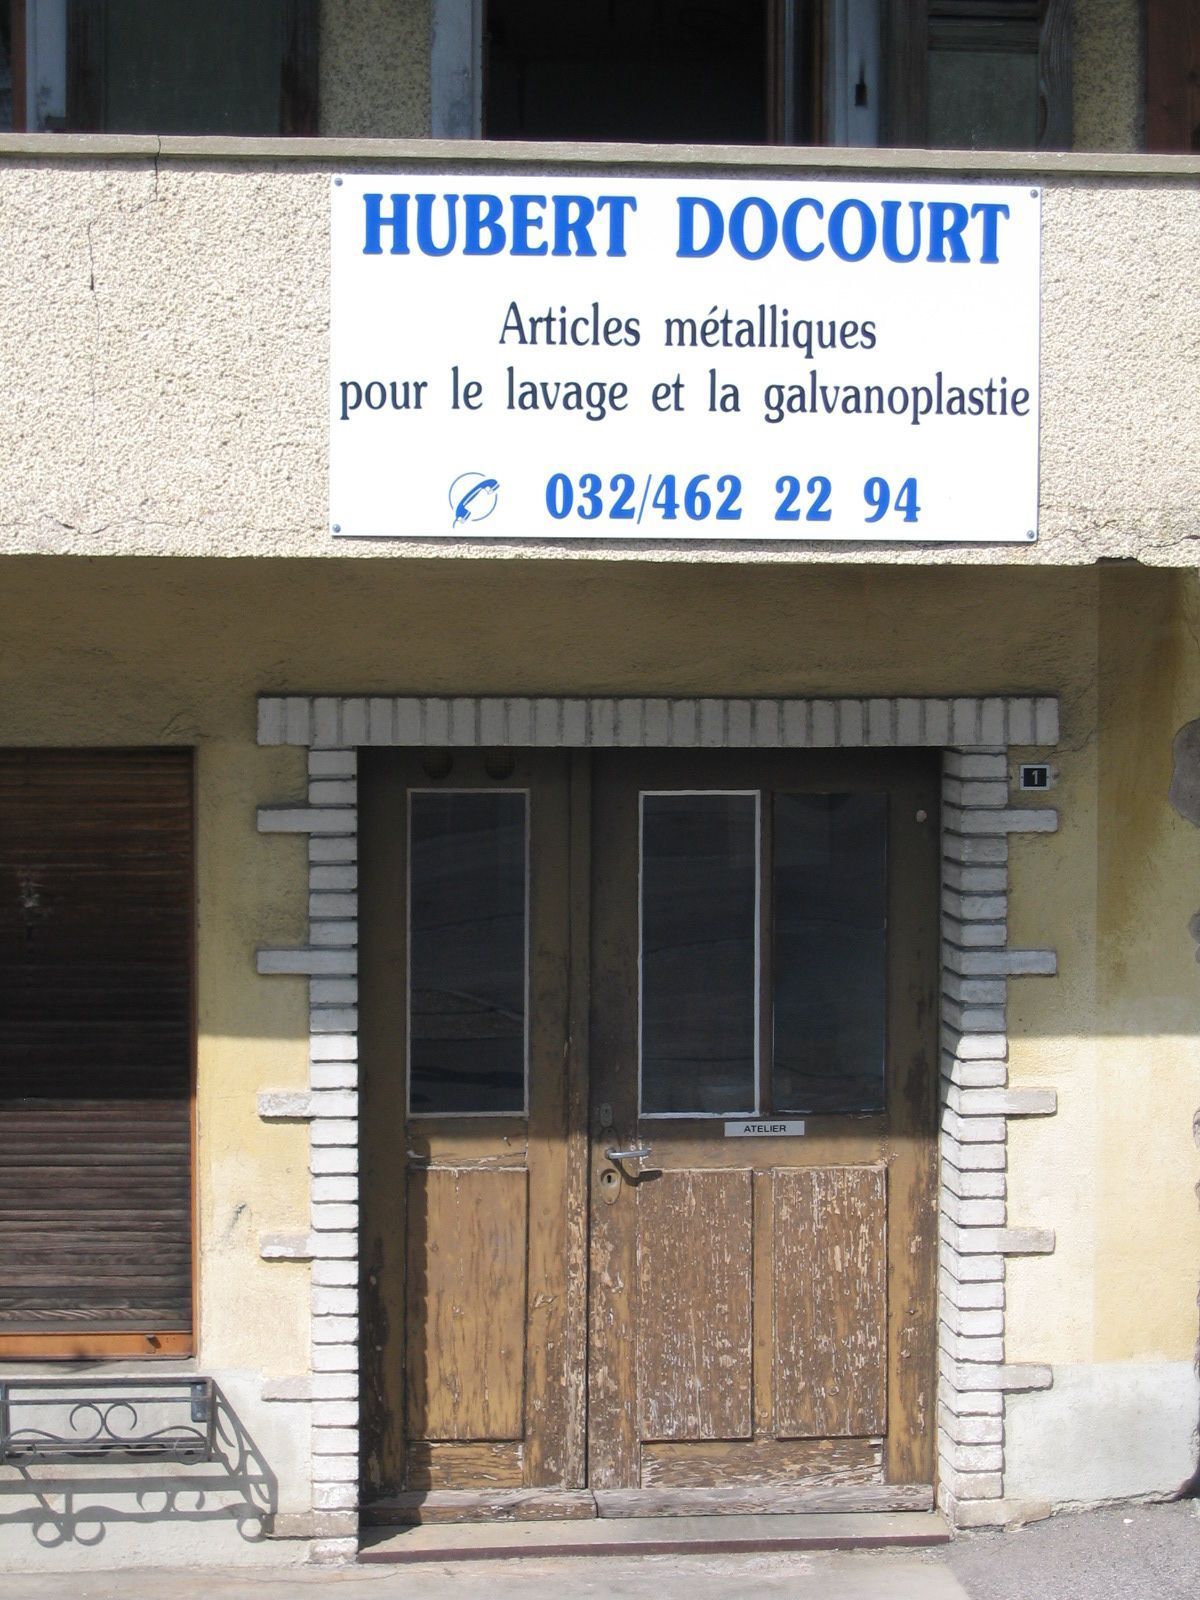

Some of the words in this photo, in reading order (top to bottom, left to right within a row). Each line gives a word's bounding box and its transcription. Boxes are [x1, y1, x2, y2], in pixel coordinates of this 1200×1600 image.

[362, 193, 637, 257] HUBERT
[676, 196, 1010, 264] DOCOURT
[499, 301, 641, 346] Articles
[664, 303, 877, 360] métalliques
[340, 381, 428, 421] pour
[451, 365, 483, 411] le
[506, 366, 628, 421] lavage
[652, 373, 685, 412] et
[708, 368, 741, 413] la
[765, 369, 1030, 426] galvanoplastie
[545, 472, 743, 525] 032/462
[774, 475, 832, 522] 22
[863, 476, 921, 523] 94
[1032, 770, 1038, 785] 1
[743, 1124, 787, 1133] ATELIER
